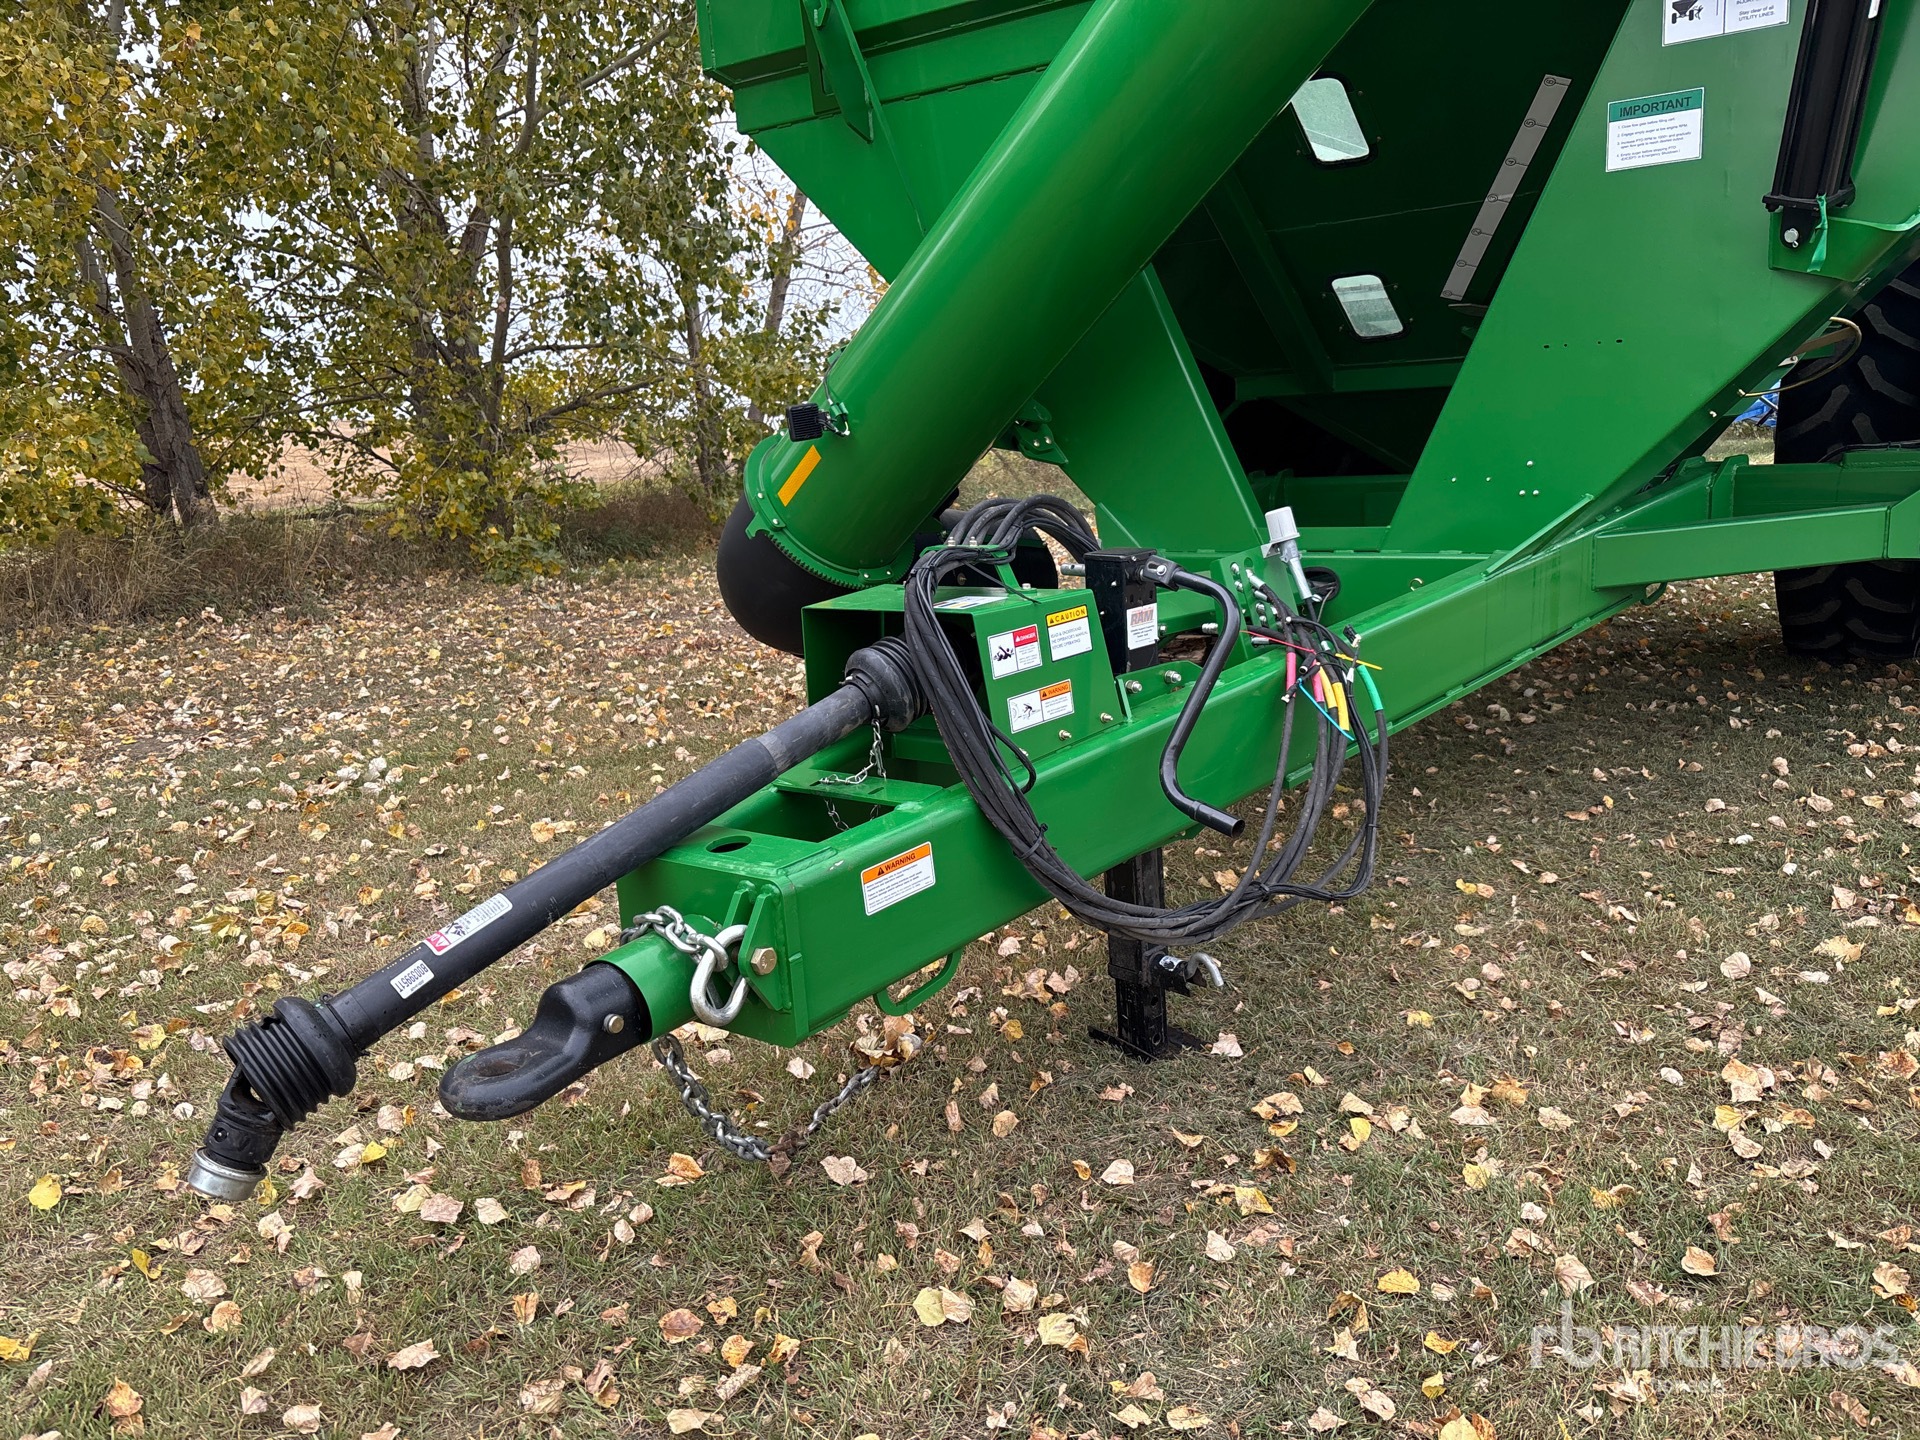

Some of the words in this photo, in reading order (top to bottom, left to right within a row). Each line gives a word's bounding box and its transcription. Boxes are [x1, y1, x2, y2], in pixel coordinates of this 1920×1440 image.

[1620, 97, 1692, 117] IMPORTANT
[1055, 608, 1085, 622] CAUTION
[1131, 610, 1153, 625] RAM
[1048, 684, 1068, 695] WARNING
[885, 853, 916, 871] WARNING
[394, 963, 429, 993] B0039951T
